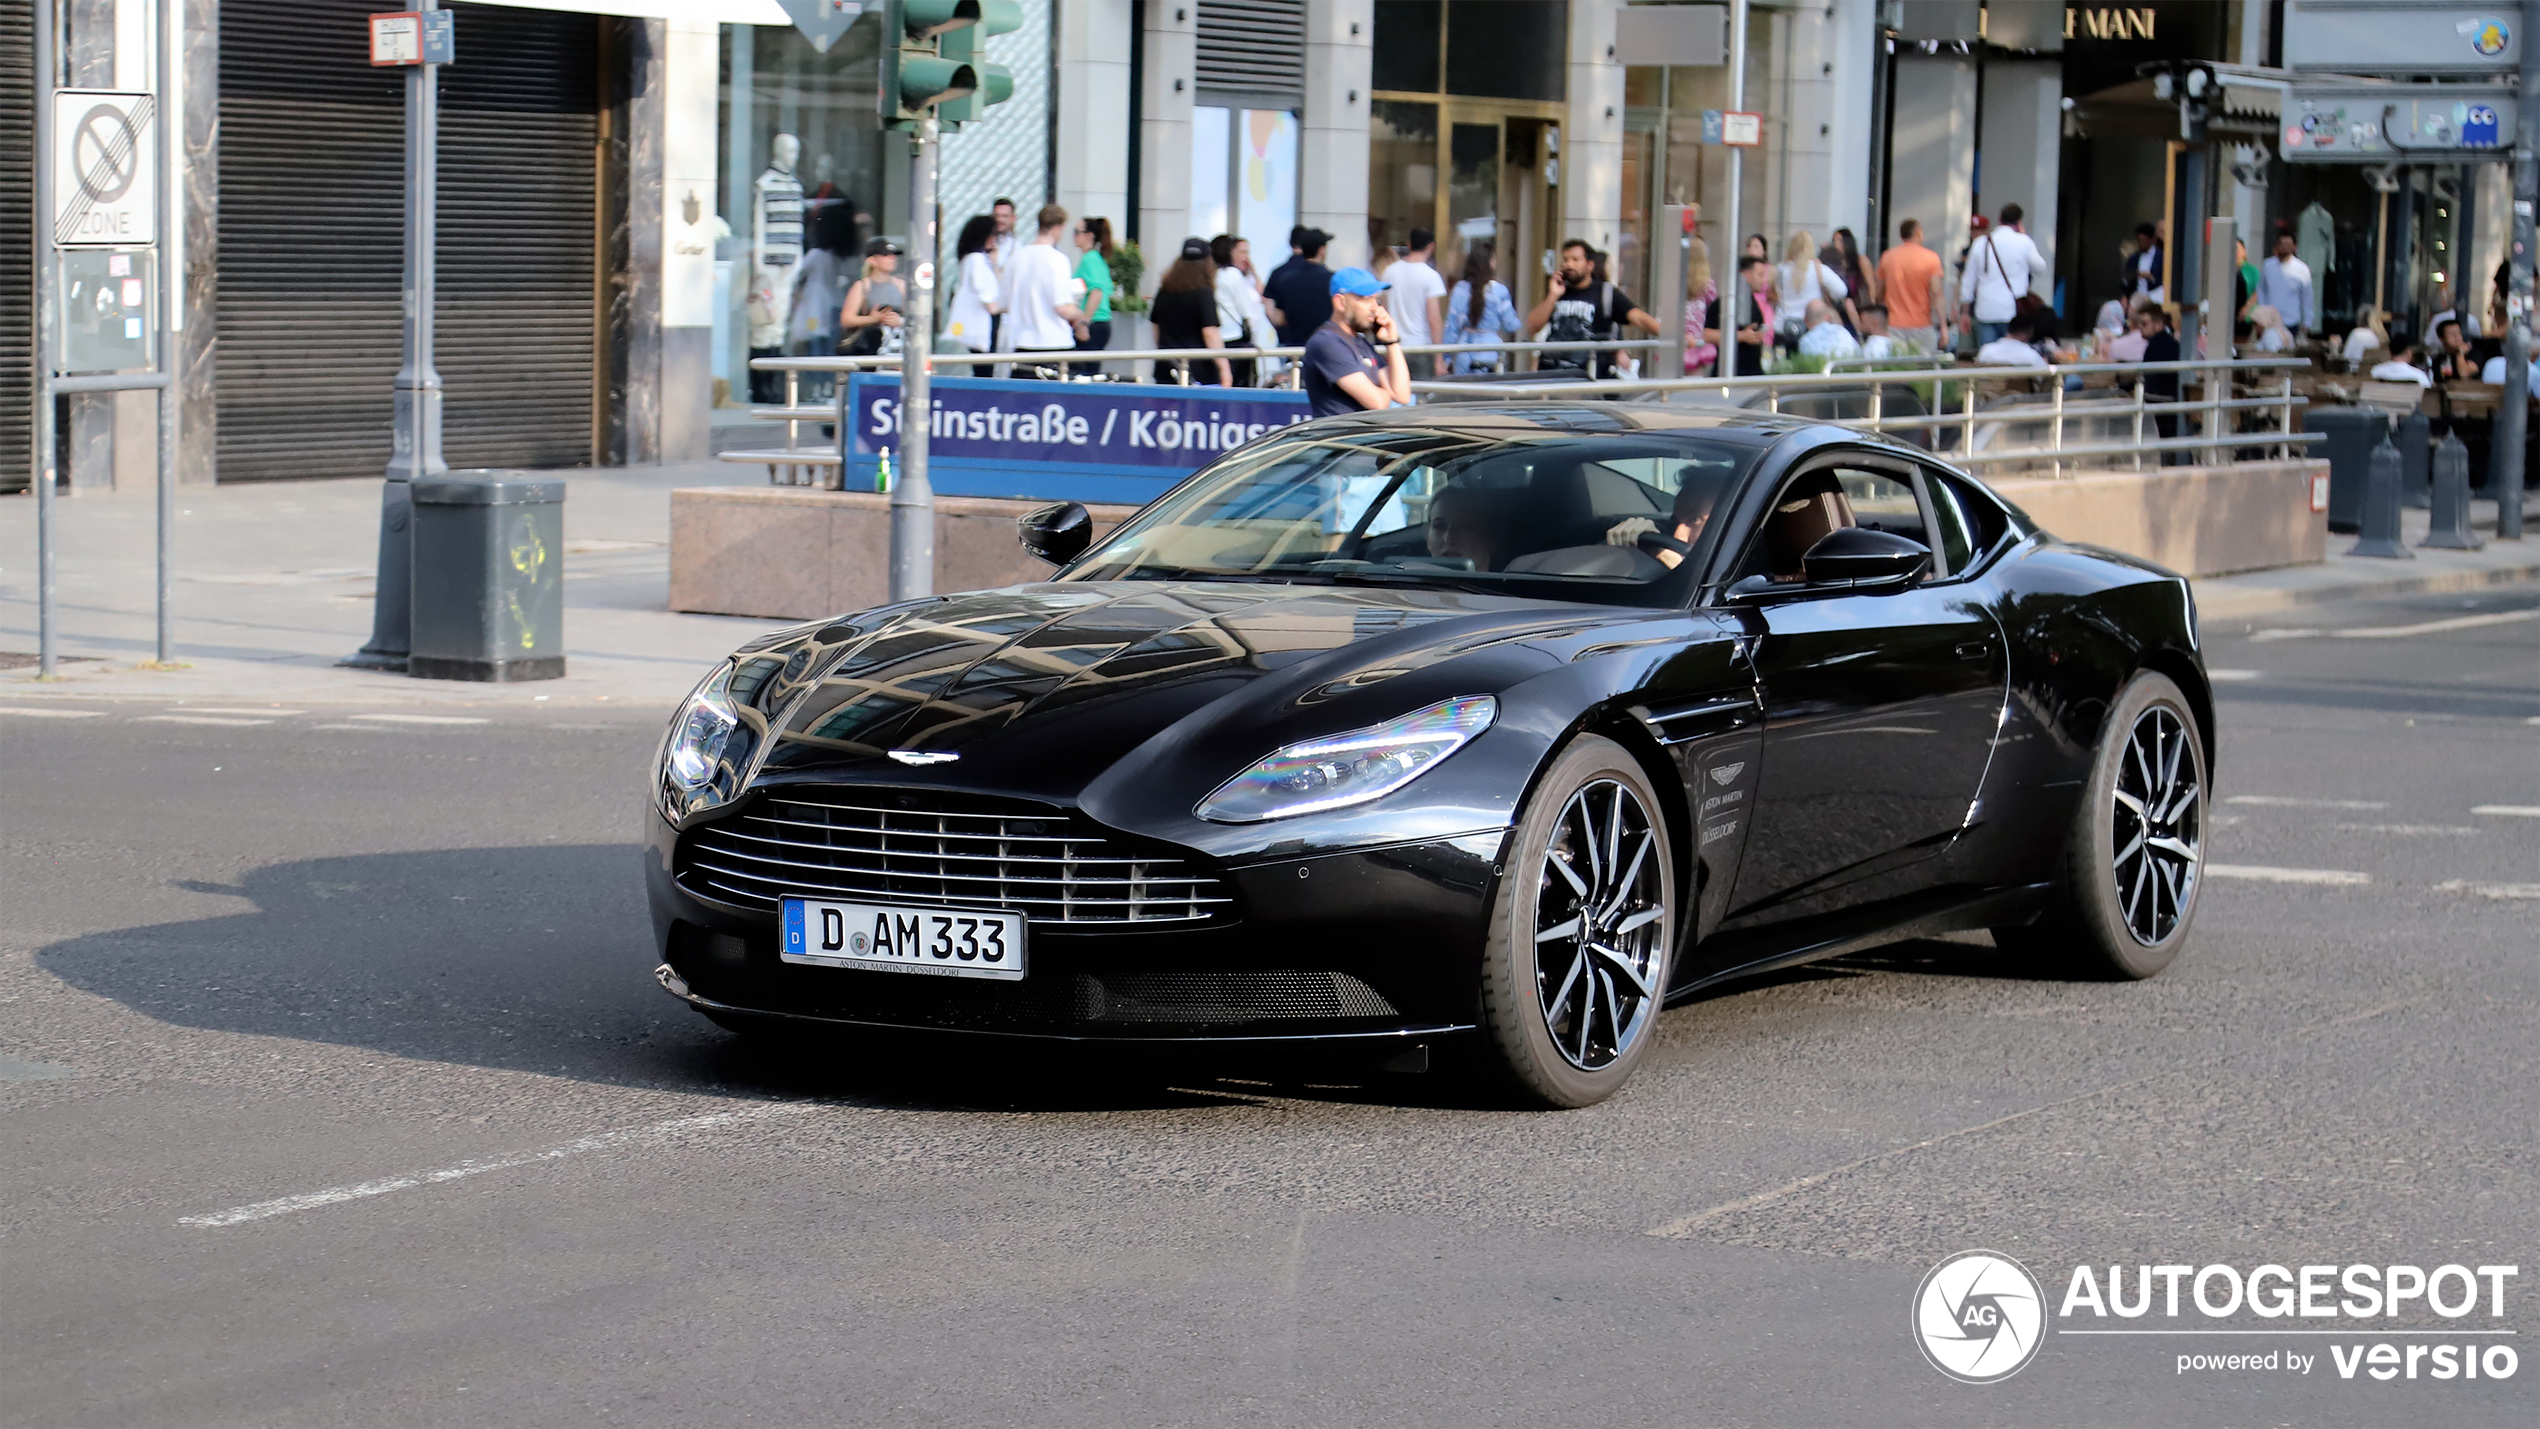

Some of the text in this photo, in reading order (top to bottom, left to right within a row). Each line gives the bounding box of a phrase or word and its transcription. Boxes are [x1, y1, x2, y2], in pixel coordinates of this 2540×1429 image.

[80, 211, 130, 234] ZONE
[870, 398, 1090, 445] Stinstraße
[1129, 409, 1313, 451] Königs
[1722, 789, 1744, 805] MARTIN
[791, 932, 800, 945] D
[820, 907, 1006, 963] D AM 333
[839, 960, 867, 970] ASTON
[870, 963, 902, 973] MARTIN
